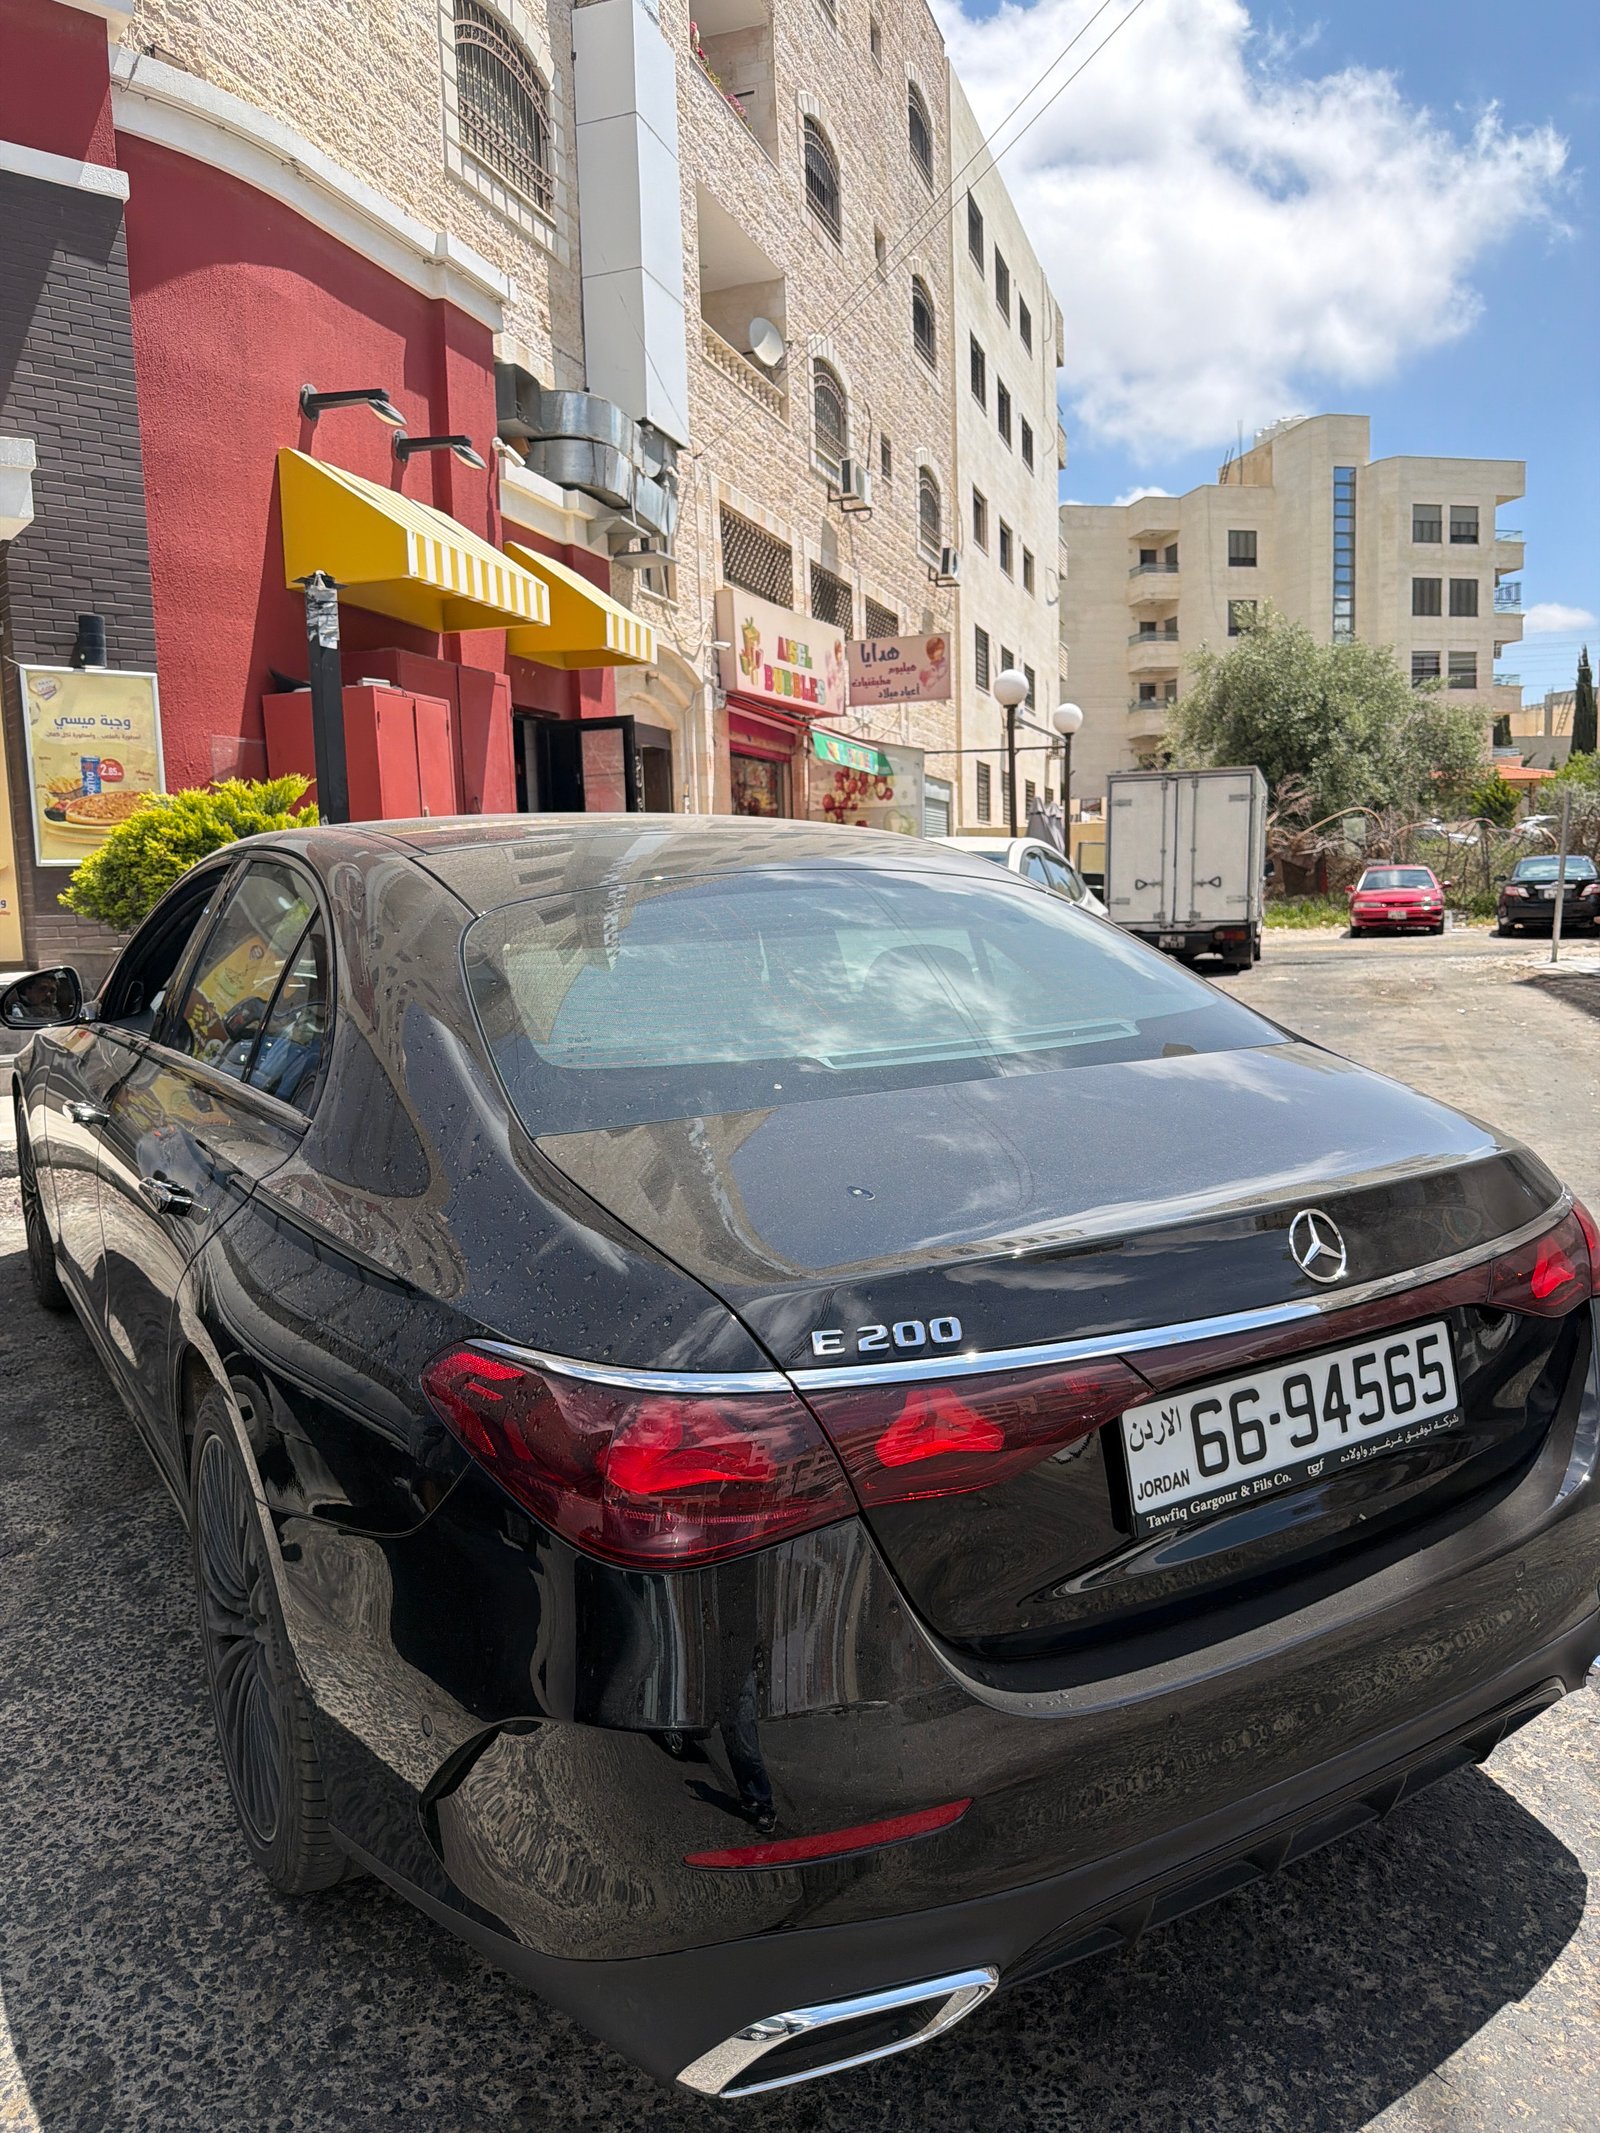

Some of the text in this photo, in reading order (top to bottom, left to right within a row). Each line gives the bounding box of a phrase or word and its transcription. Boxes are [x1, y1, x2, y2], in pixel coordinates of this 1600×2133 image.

[861, 642, 900, 668] هدايا
[764, 664, 826, 705] BUBBLES
[878, 687, 899, 699] ميلاد
[54, 715, 131, 730] وجبة ميسي
[812, 1316, 963, 1356] E 200
[1405, 1423, 1432, 1444] توفيق
[1433, 1413, 1460, 1430] شركة
[1137, 1468, 1191, 1500] JORDAN
[1146, 1471, 1292, 1529] Tawfiq Gargour & Fils Co.
